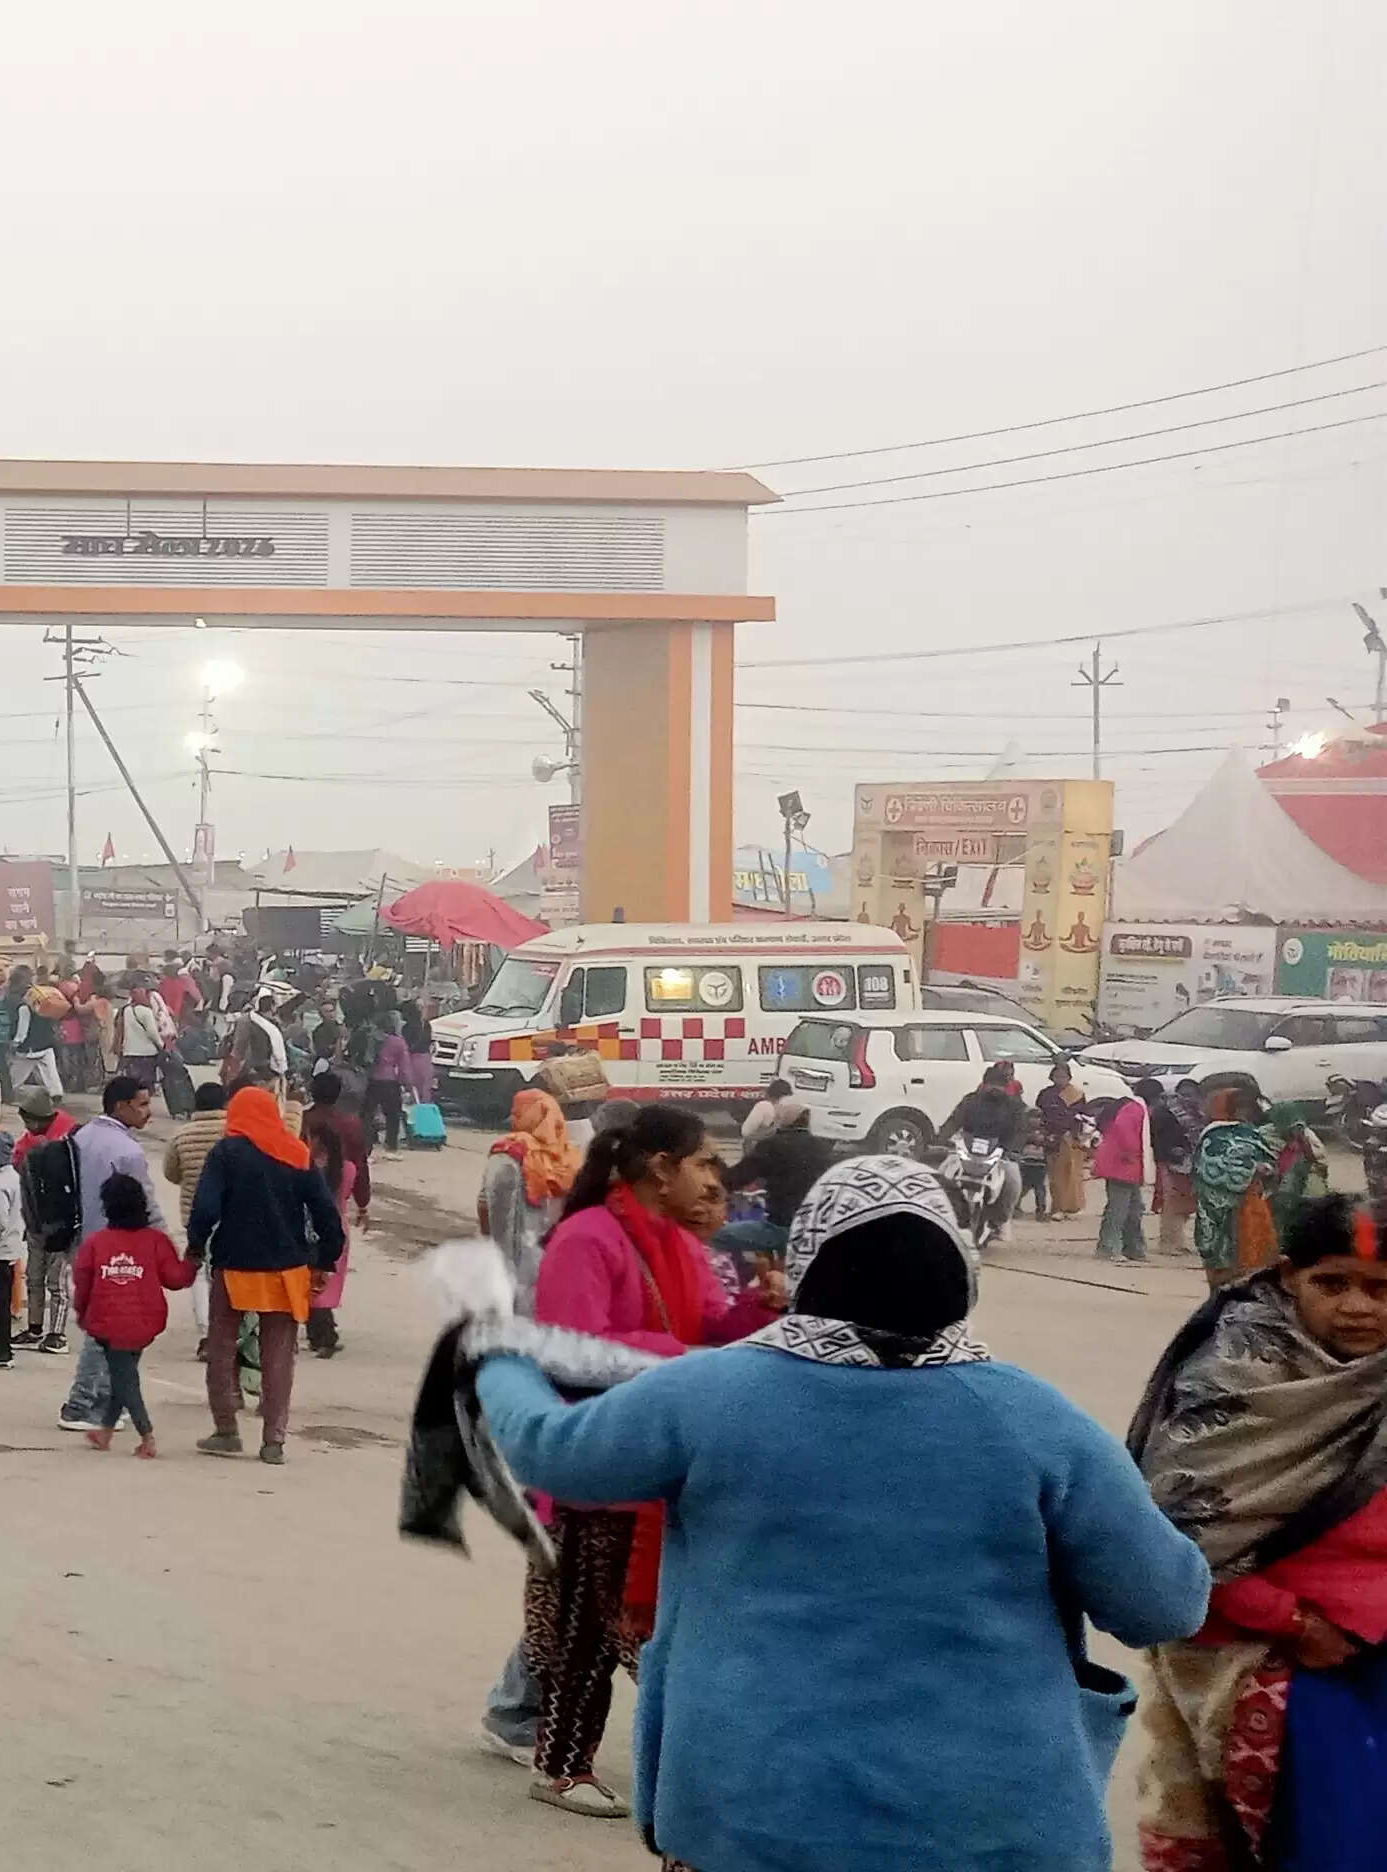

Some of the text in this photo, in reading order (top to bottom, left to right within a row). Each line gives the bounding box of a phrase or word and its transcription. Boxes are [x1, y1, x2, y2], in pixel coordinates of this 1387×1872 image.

[962, 838, 987, 856] EXIT
[864, 976, 888, 991] 108
[698, 1087, 736, 1099] प्रदेश
